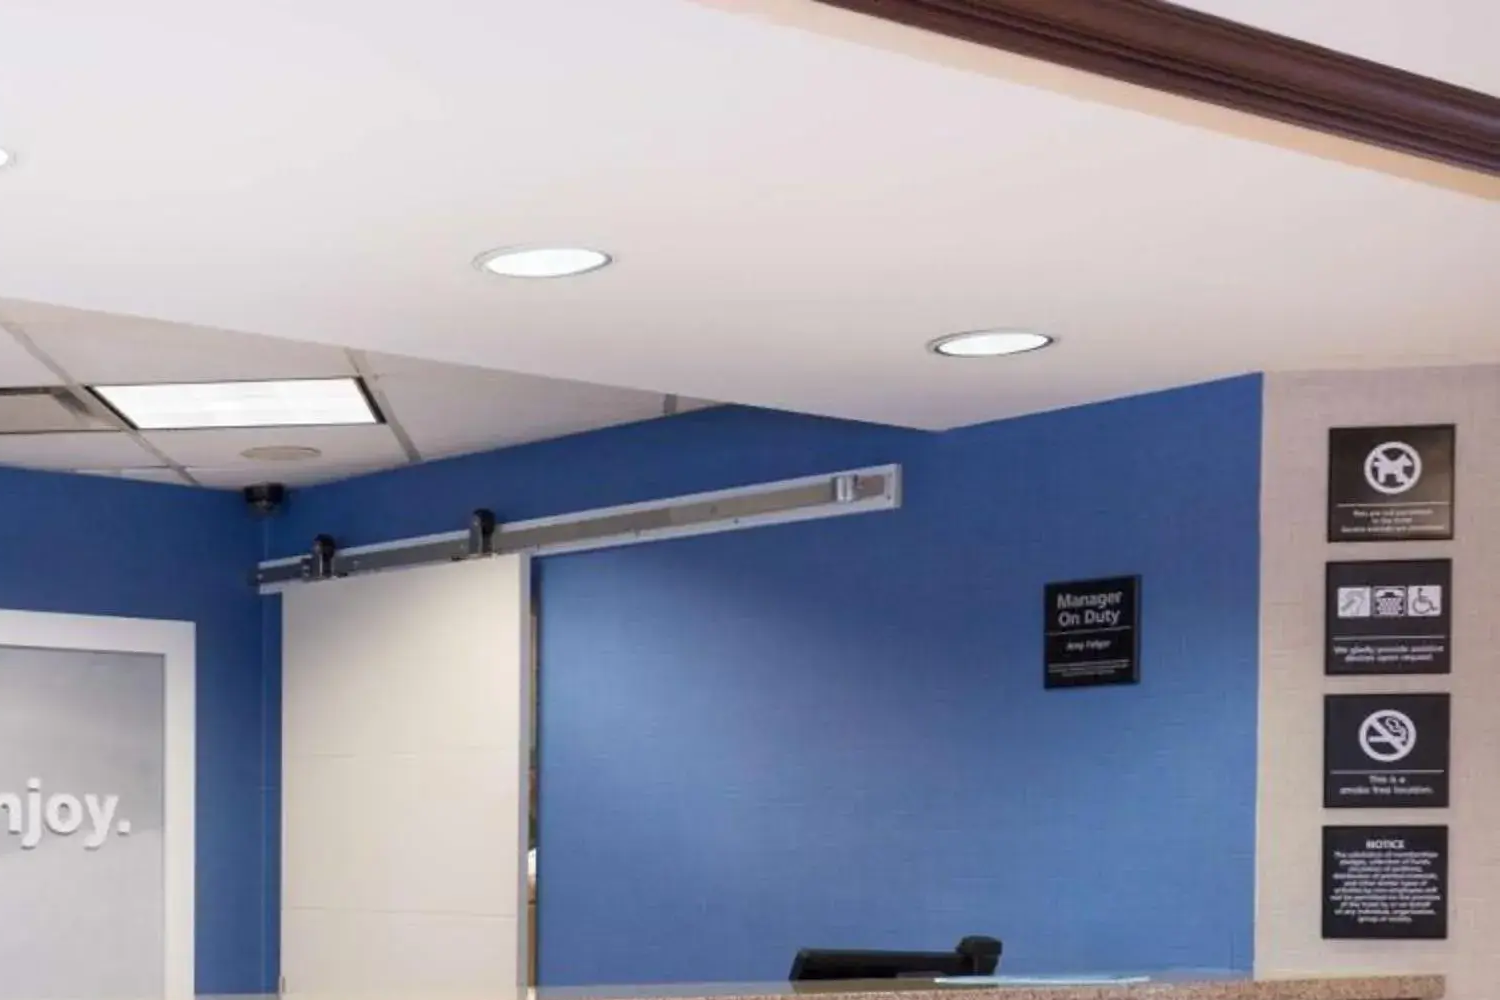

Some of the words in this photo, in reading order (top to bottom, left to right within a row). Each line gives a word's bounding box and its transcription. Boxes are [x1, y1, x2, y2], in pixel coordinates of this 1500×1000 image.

[1057, 591, 1123, 609] Manager
[1058, 611, 1080, 626] On
[1084, 609, 1120, 625] Duty
